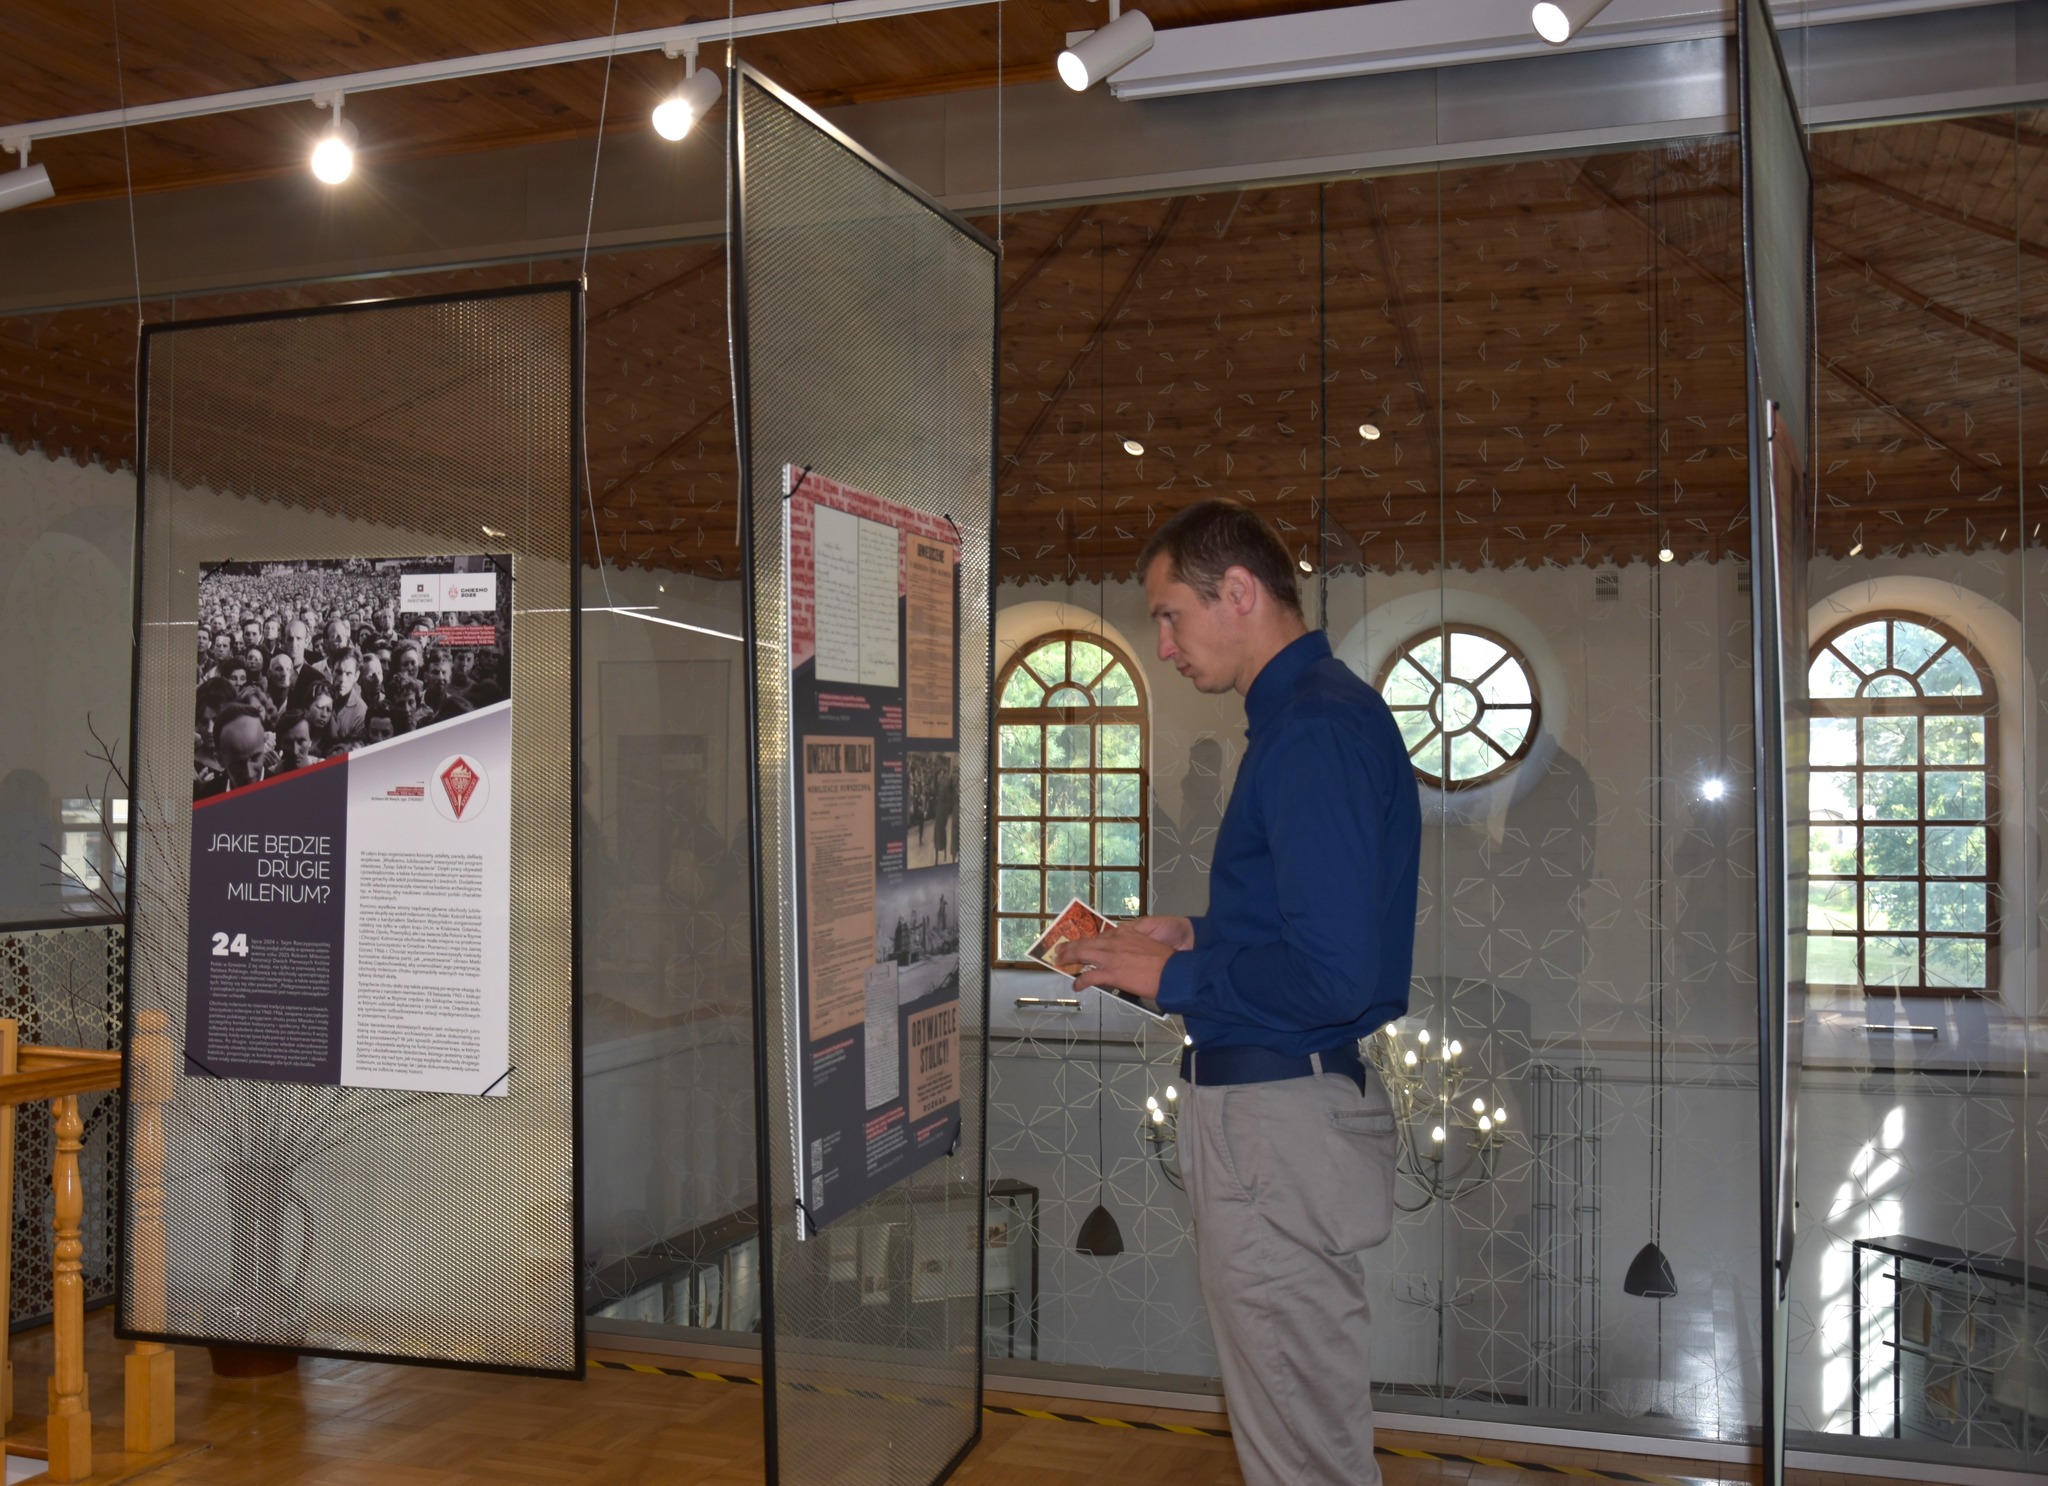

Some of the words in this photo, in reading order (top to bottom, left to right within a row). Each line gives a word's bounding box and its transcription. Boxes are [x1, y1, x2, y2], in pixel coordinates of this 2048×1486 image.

[208, 833, 259, 853] JAKIE
[264, 835, 331, 858] BĘDZIE
[258, 859, 330, 879] DRUGIE
[228, 882, 331, 904] MILENIUM?
[212, 932, 249, 957] 24
[912, 1008, 956, 1048] OBYWATELE
